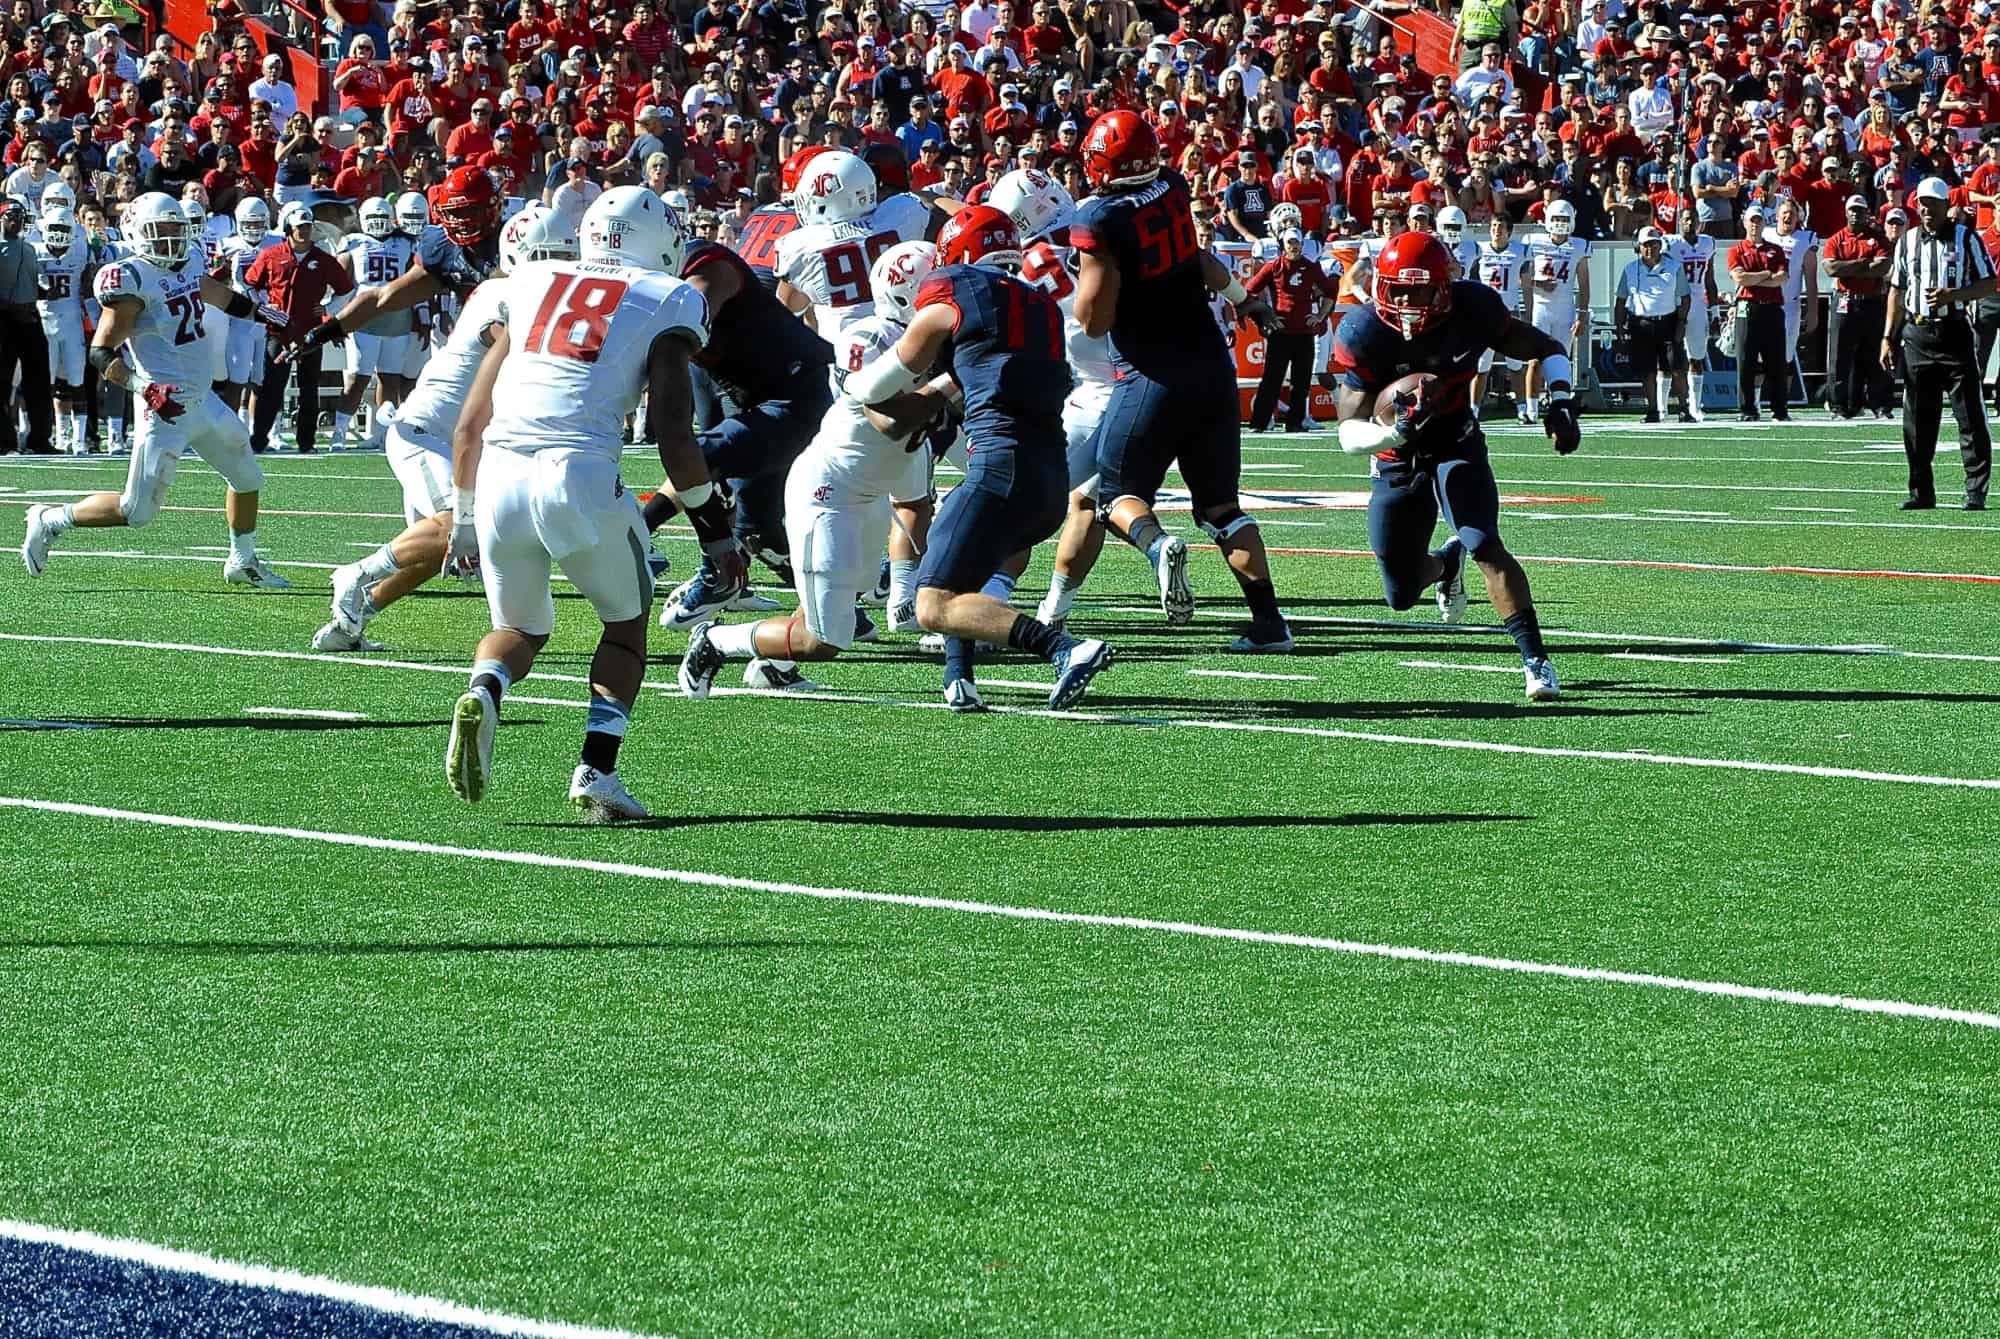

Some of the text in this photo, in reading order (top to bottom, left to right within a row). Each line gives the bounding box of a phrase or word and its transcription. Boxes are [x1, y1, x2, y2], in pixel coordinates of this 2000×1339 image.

[1244, 190, 1264, 212] A
[368, 256, 399, 281] 95
[1684, 261, 1706, 283] 87
[1948, 266, 1956, 277] R
[524, 271, 629, 363] 18
[848, 343, 865, 372] 8
[1246, 341, 1265, 364] G
